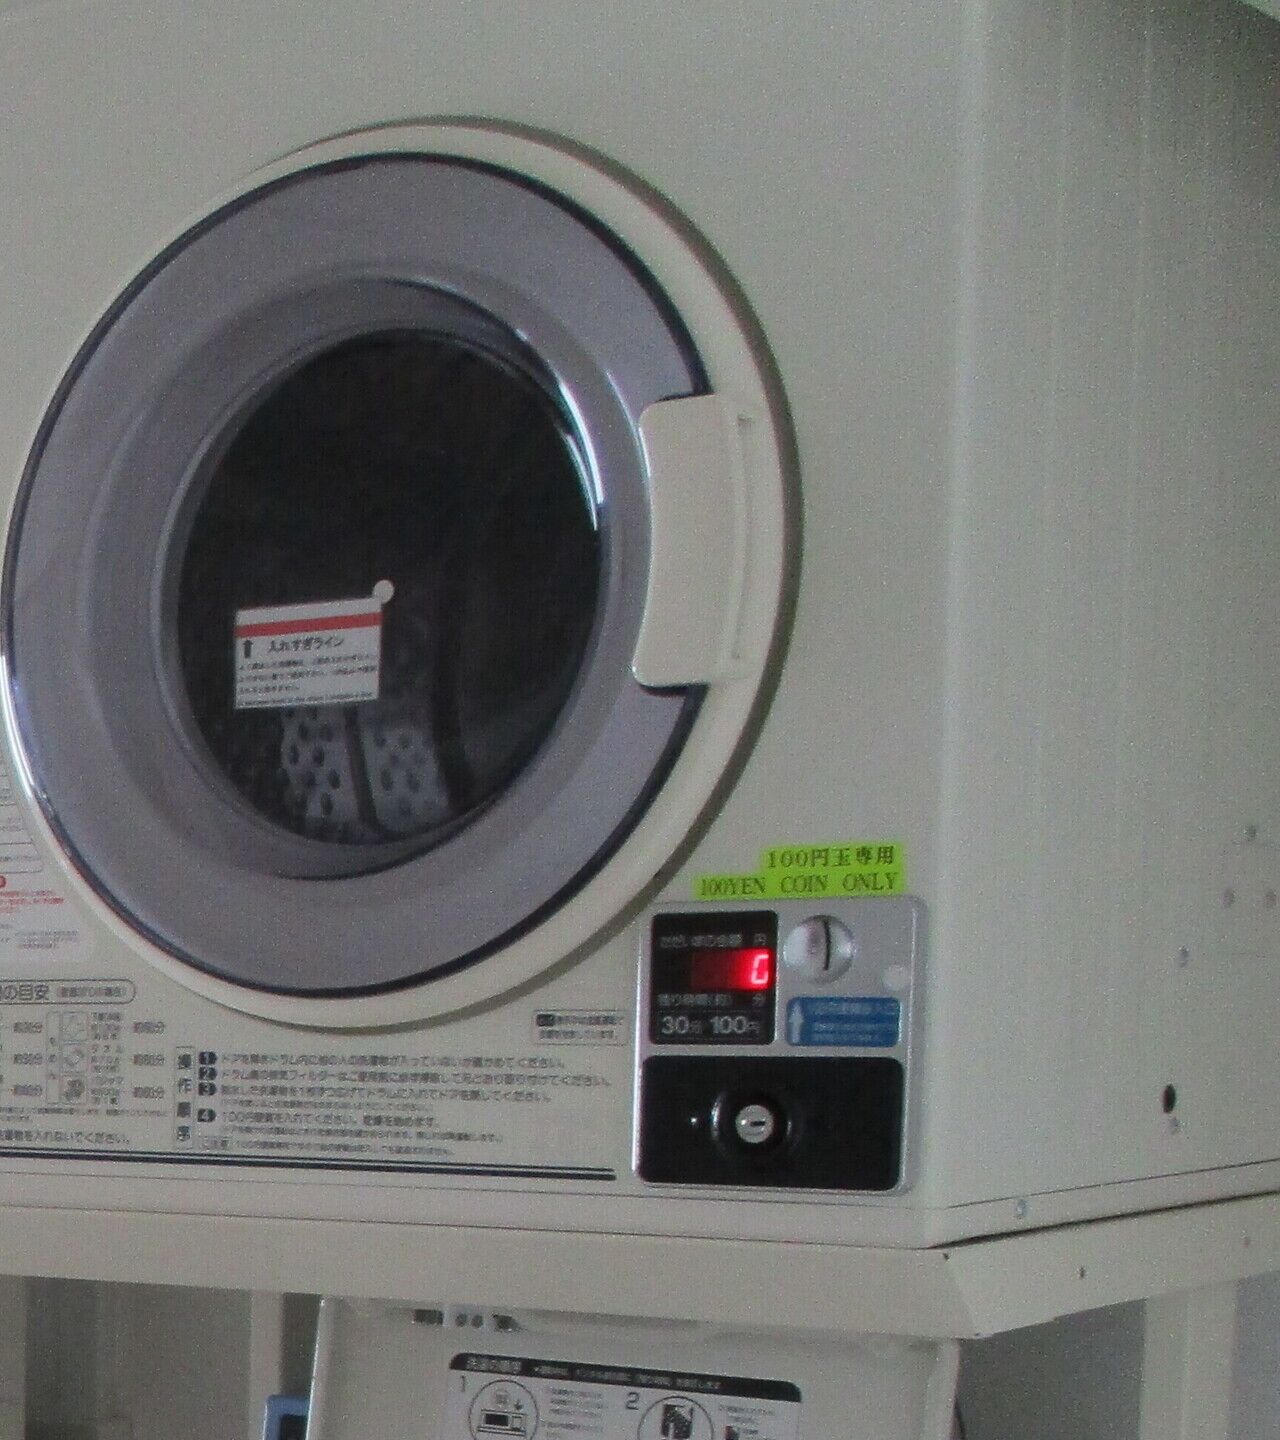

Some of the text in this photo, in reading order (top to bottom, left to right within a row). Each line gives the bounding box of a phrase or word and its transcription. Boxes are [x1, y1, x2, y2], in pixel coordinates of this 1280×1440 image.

[767, 845, 896, 869] 100円玉専用
[701, 872, 900, 897] 100YEN COIN ONLY
[625, 1392, 640, 1410] 2
